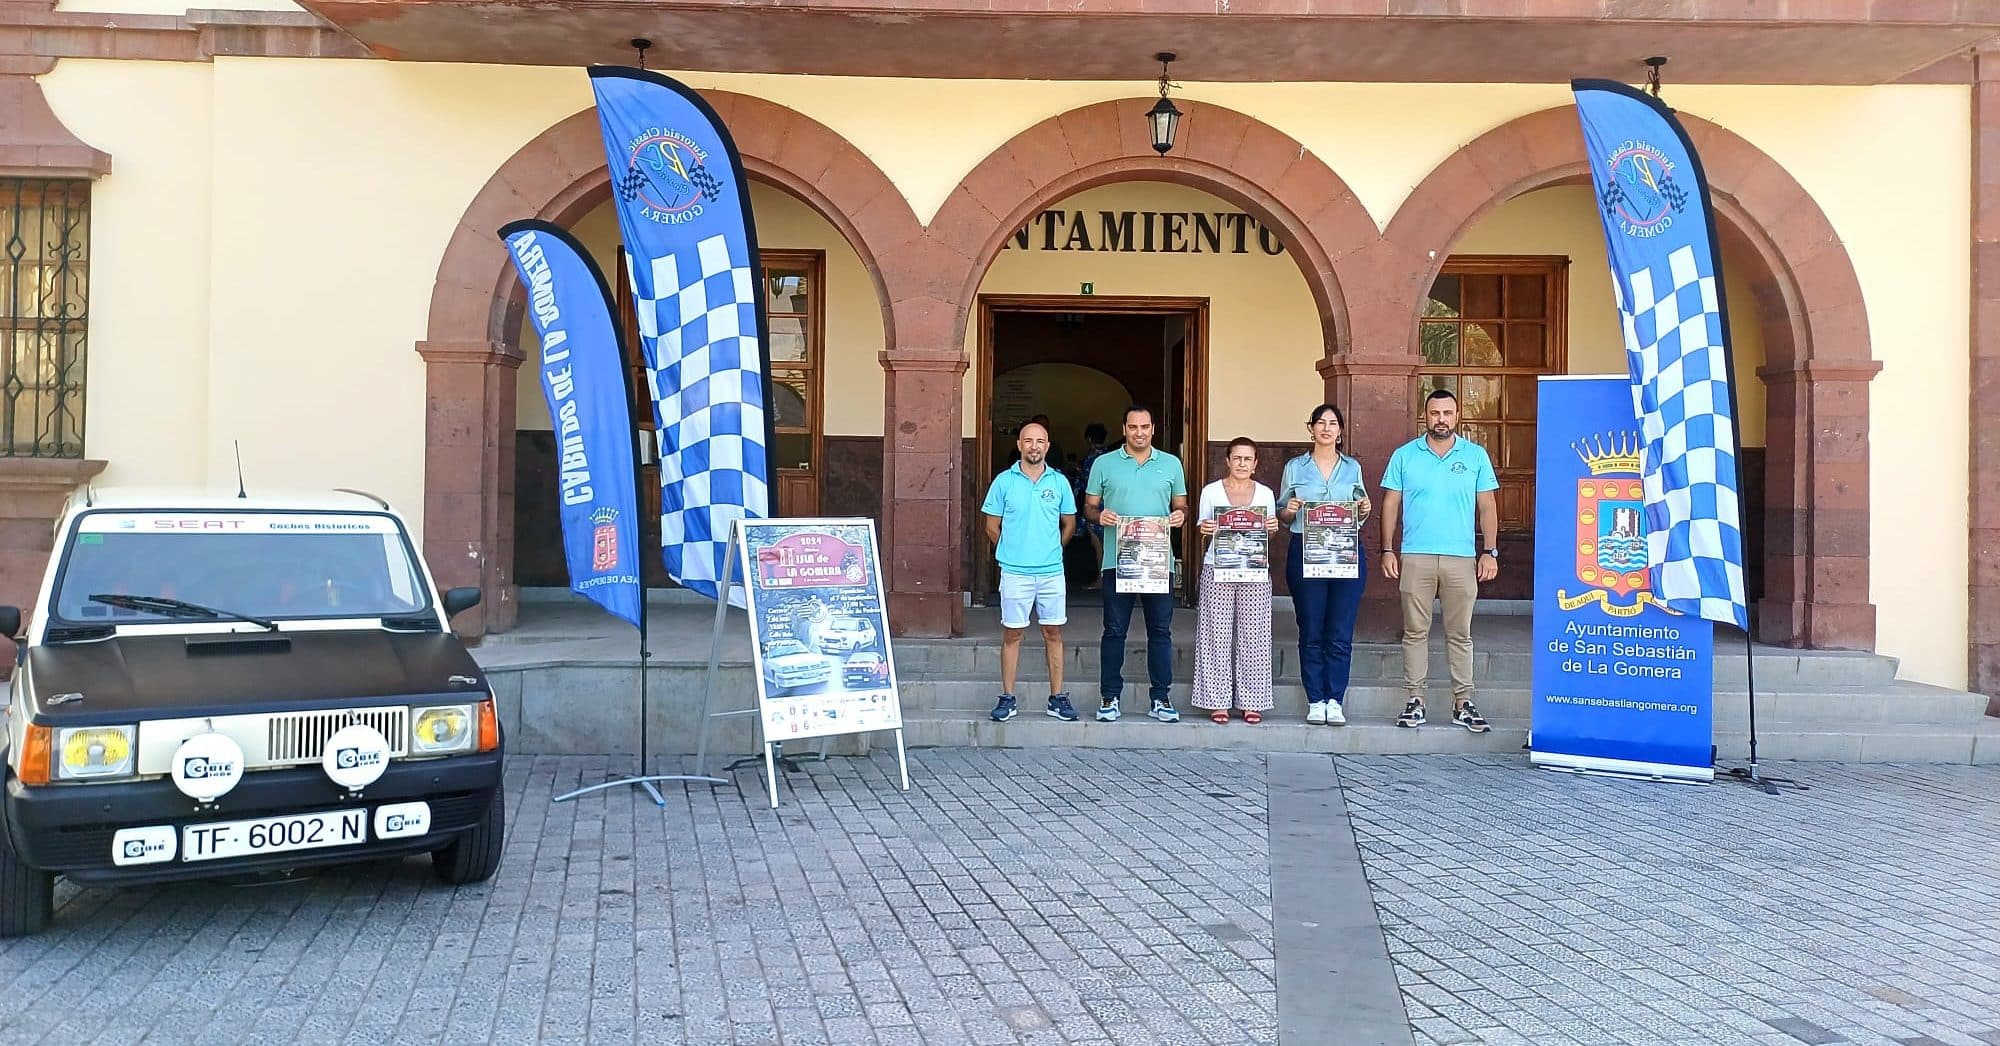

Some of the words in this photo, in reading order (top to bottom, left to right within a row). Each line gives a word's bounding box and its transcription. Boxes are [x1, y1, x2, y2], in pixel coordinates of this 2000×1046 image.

[154, 520, 245, 529] SEAT
[817, 553, 829, 563] de
[1565, 620, 1680, 640] Ayuntamiento
[1548, 639, 1569, 653] de
[1574, 640, 1607, 655] San
[1612, 642, 1696, 660] Sebastián
[1562, 658, 1583, 672] de
[1588, 660, 1608, 674] La
[1613, 661, 1682, 679] Gomera
[1546, 694, 1698, 714] www.sansebastiangomera.org
